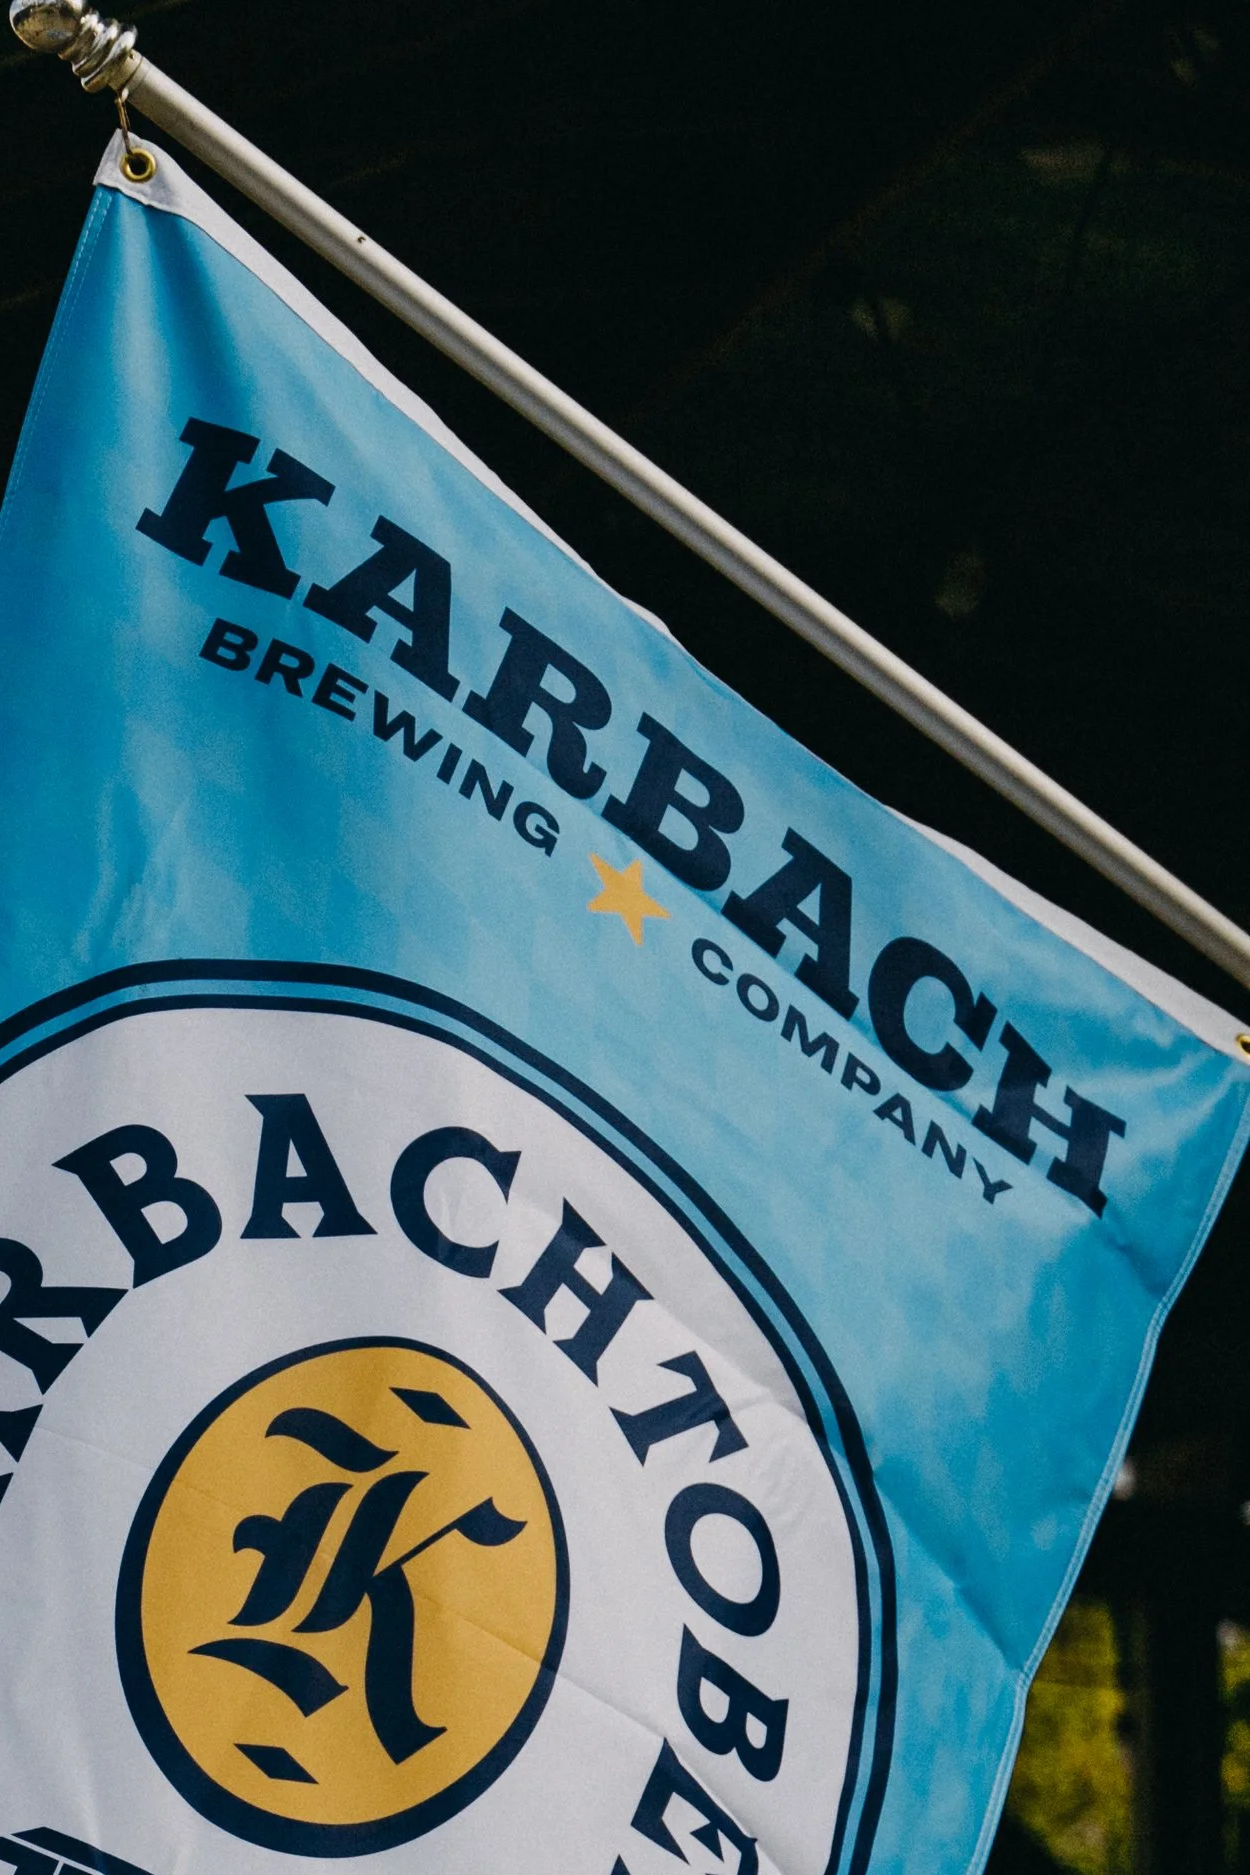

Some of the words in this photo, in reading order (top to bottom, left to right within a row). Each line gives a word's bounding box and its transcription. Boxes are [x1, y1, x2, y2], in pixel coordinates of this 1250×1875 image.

[136, 417, 1126, 1219] KARBACH
[198, 618, 561, 855] BREWING
[691, 938, 1012, 1203] COMPANY
[187, 1386, 527, 1783] K
